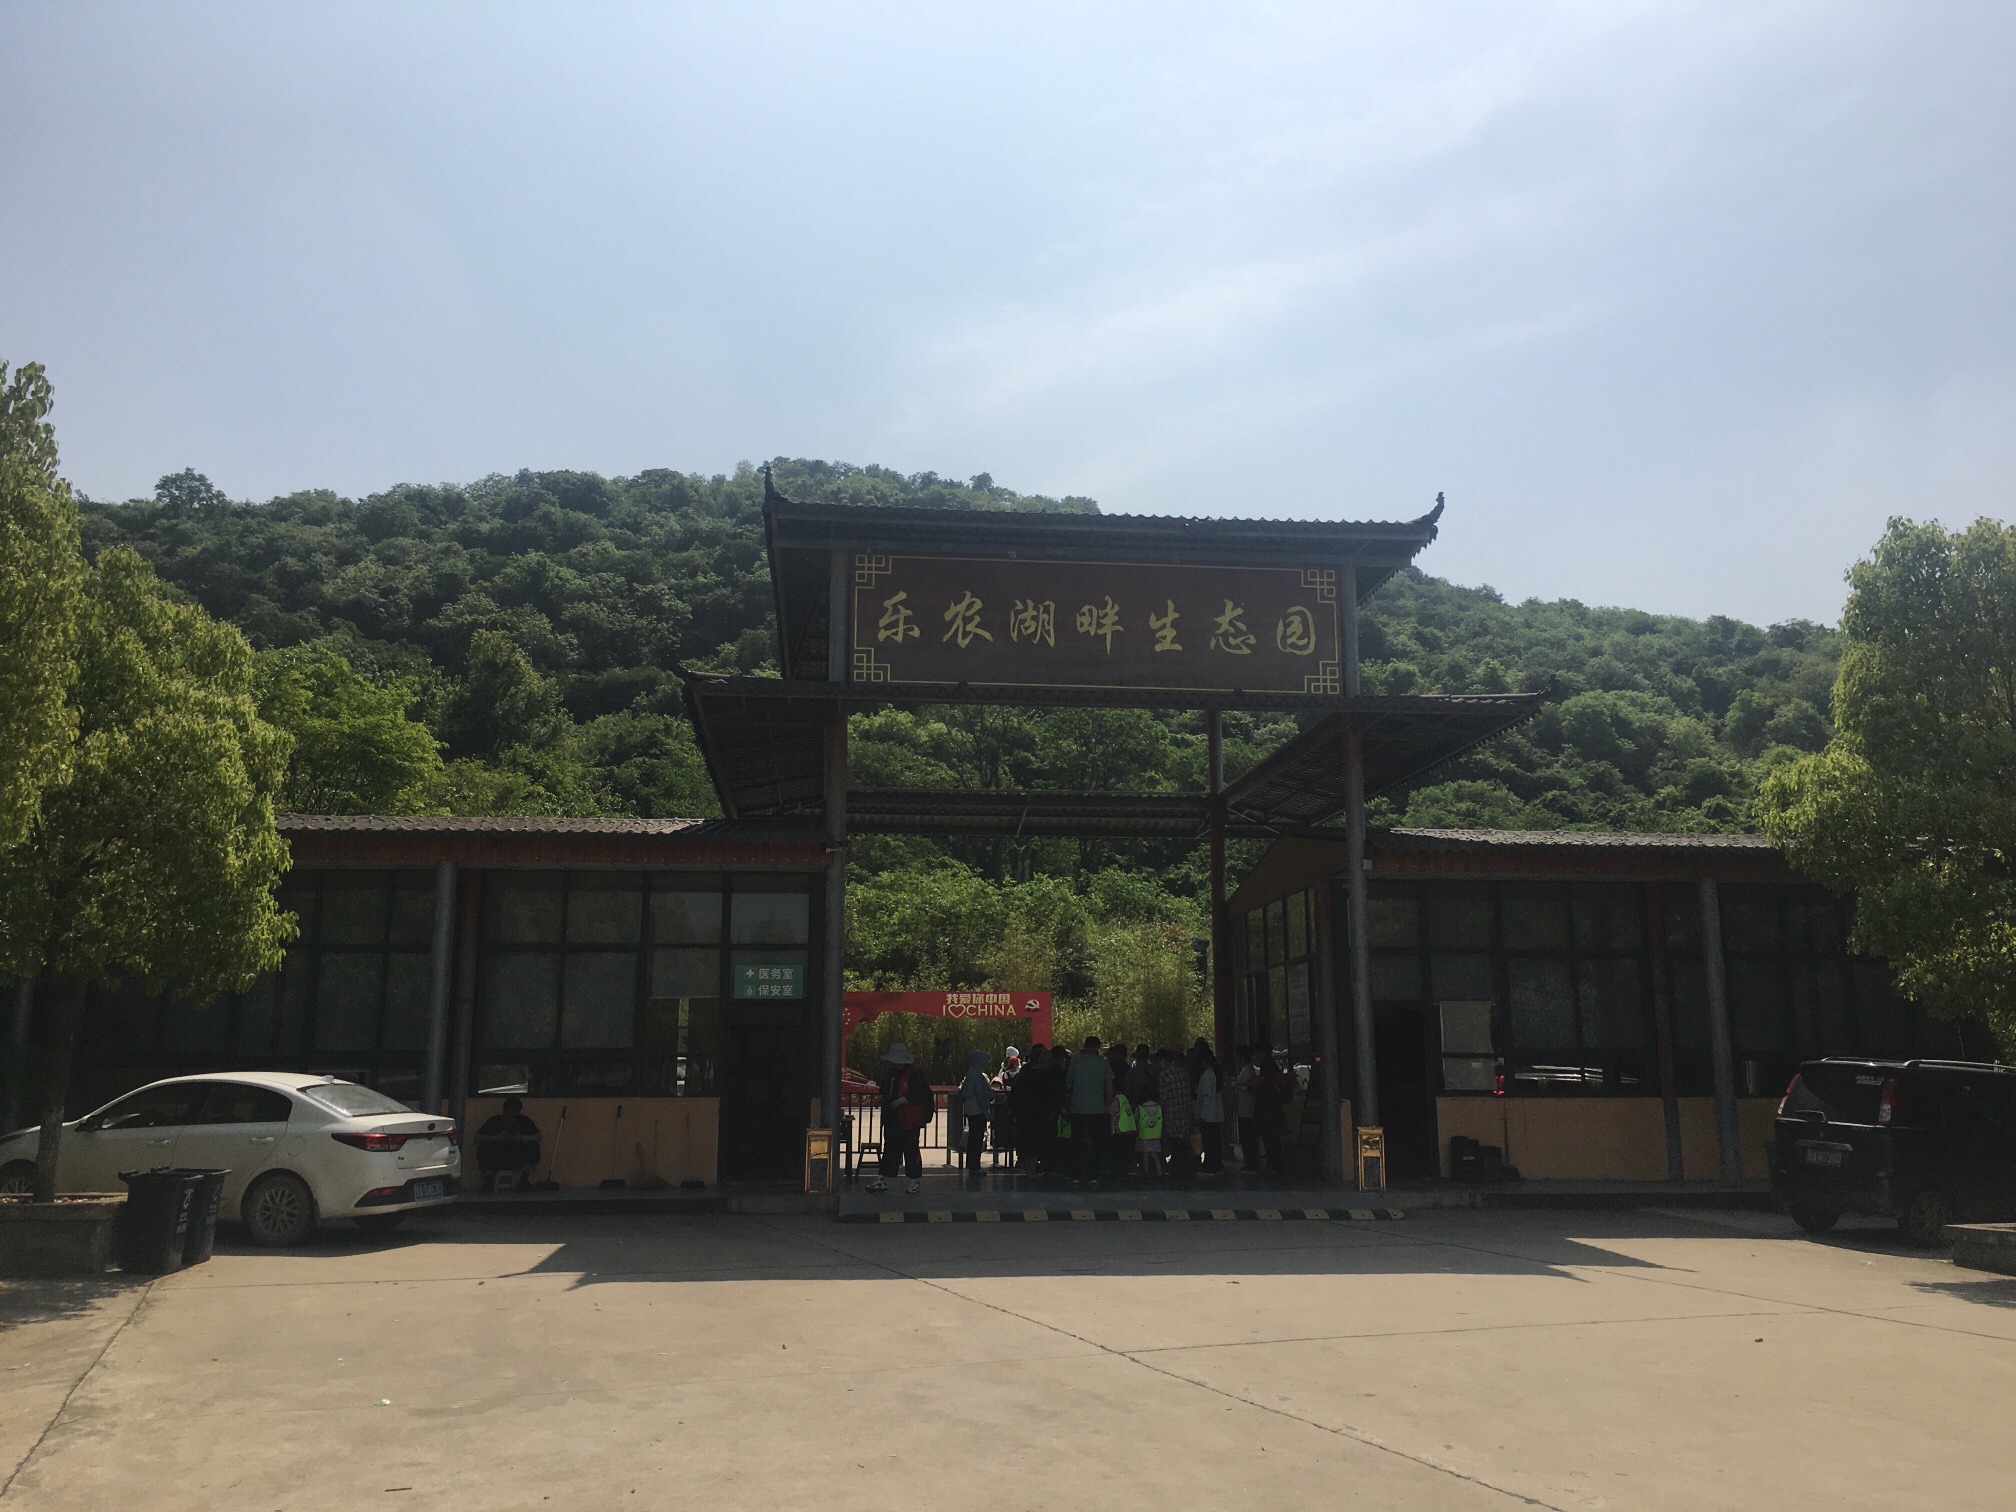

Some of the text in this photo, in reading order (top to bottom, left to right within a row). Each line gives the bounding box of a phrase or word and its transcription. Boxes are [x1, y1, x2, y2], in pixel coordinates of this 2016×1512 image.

[878, 590, 1316, 655] 乐农湖畔生态园
[759, 969, 794, 980] 医务室
[759, 985, 794, 997] 保安室
[946, 993, 1011, 1005] 我爱你中国
[966, 1004, 1017, 1016] CHINA
